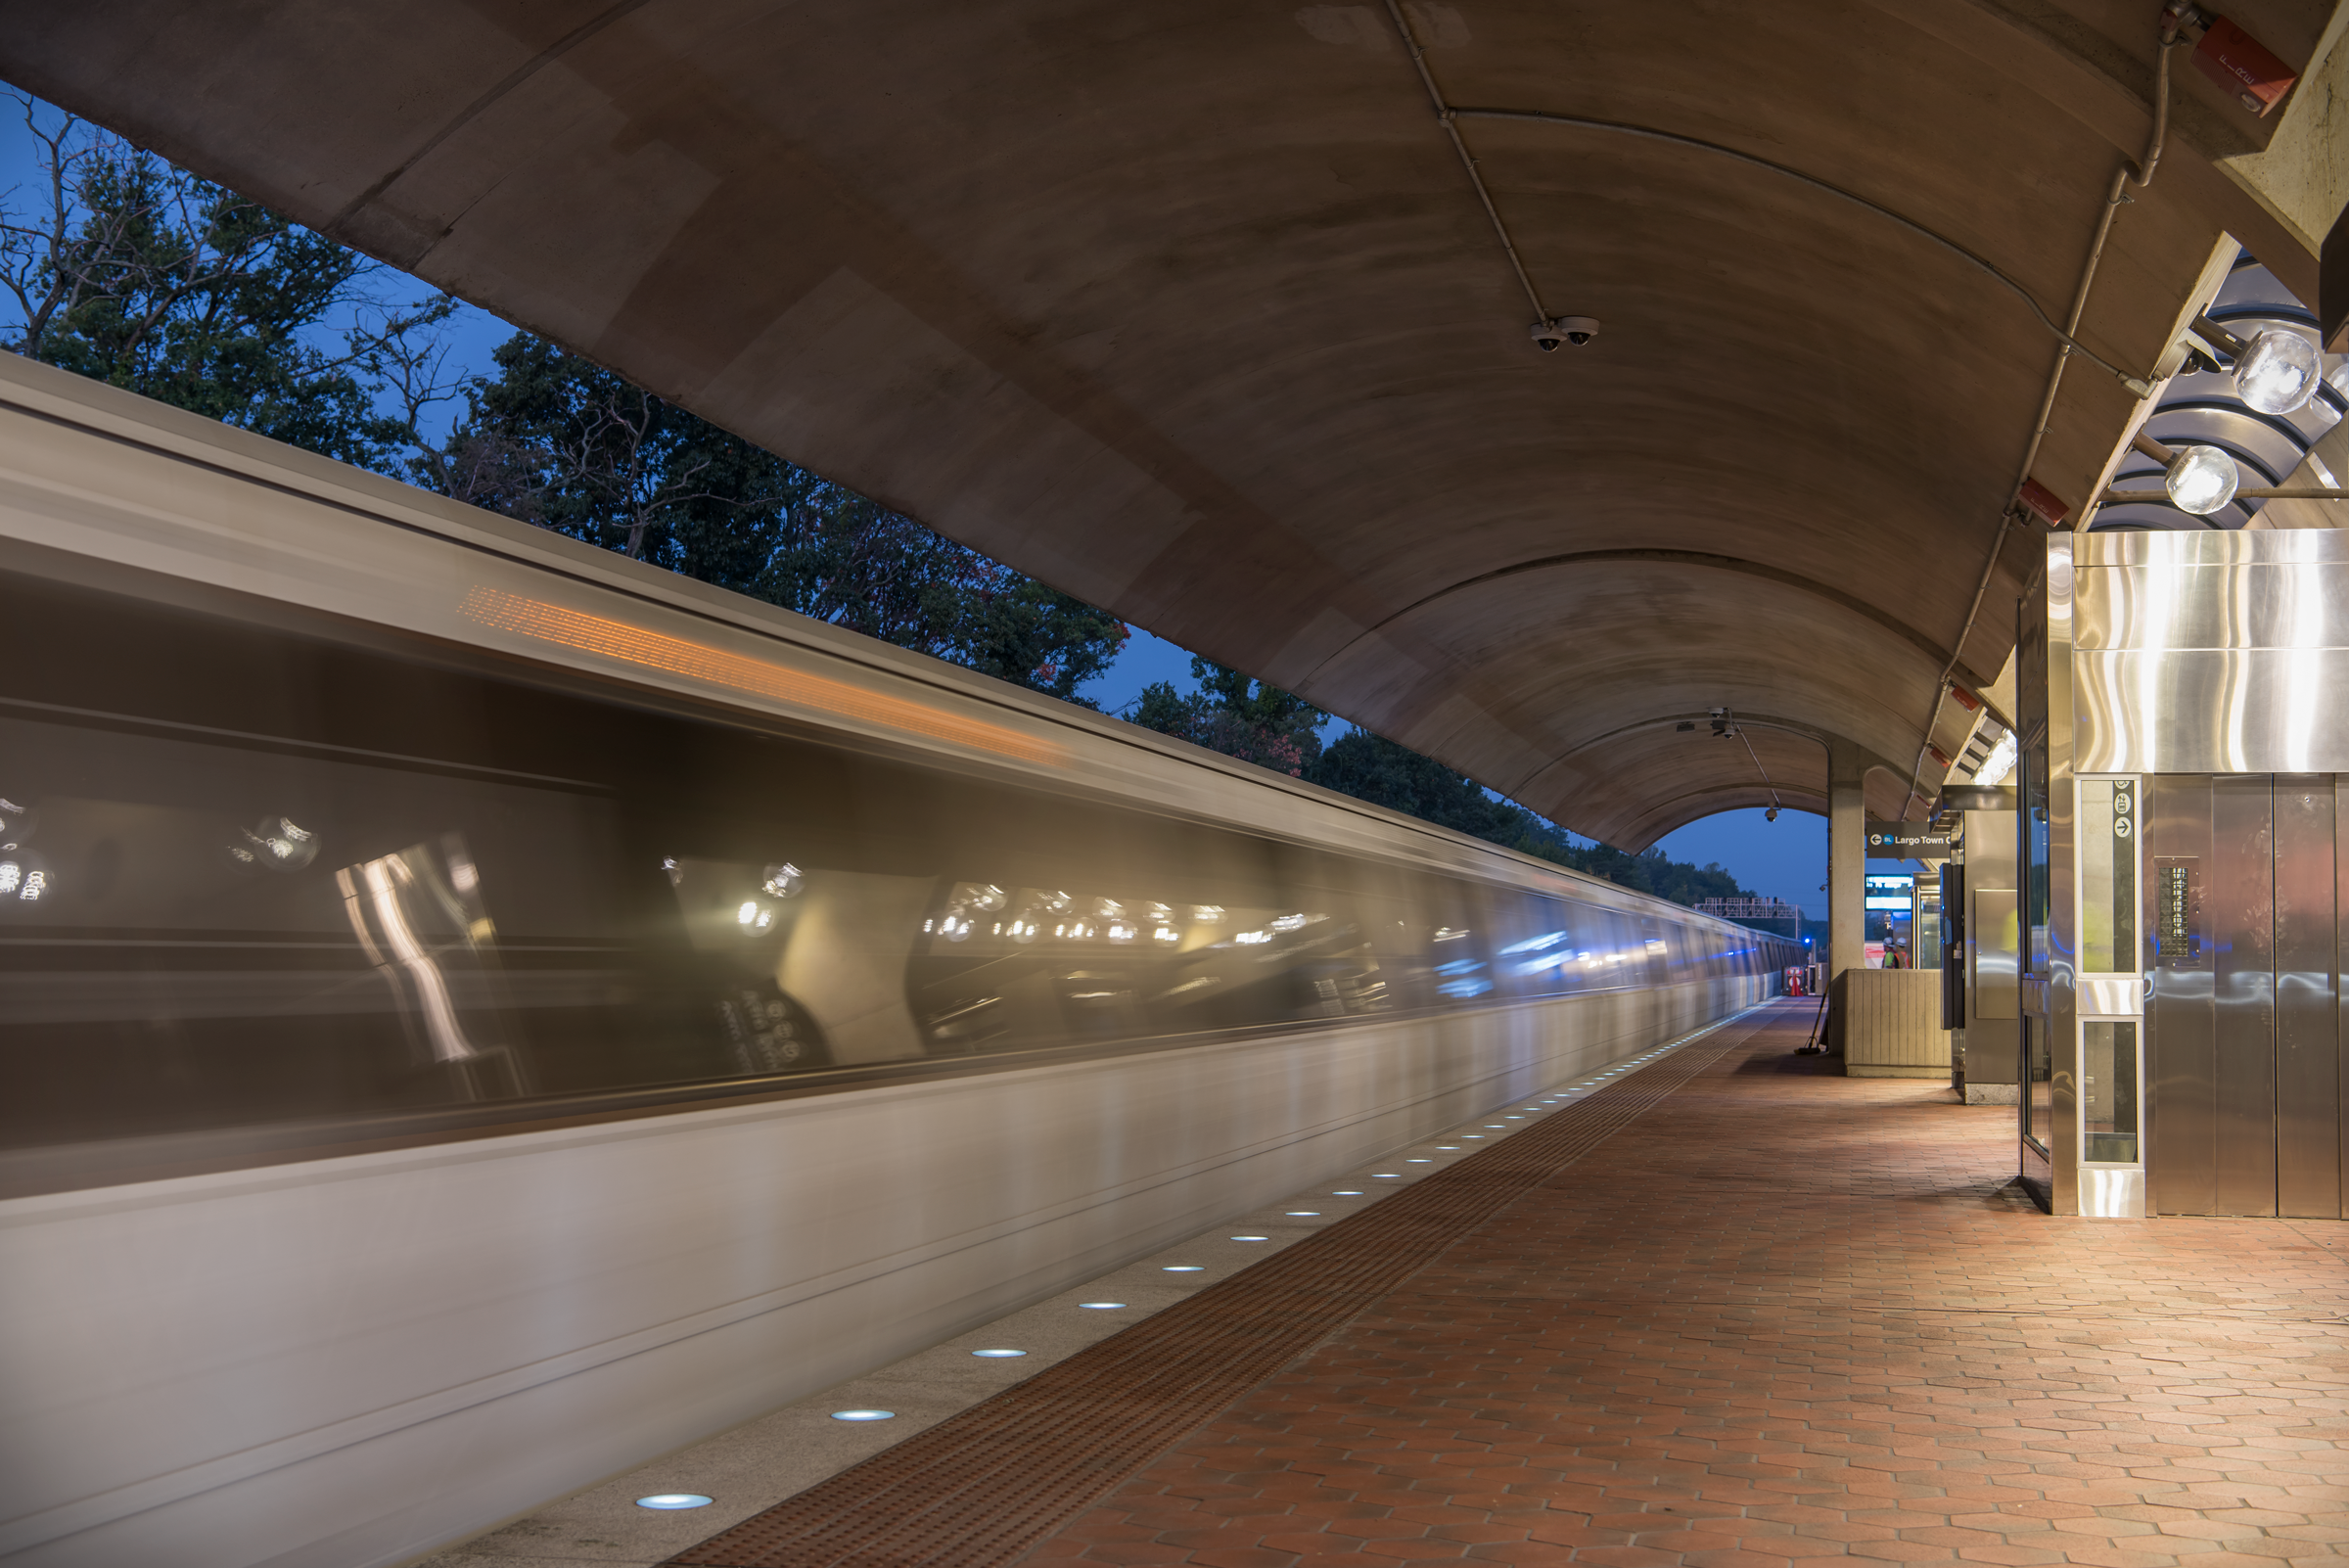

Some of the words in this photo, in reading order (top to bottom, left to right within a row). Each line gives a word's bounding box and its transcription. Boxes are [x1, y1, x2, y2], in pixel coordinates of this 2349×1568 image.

[2219, 55, 2254, 85] FIRE
[1895, 836, 1920, 846] Largo
[1920, 836, 1944, 845] Town
